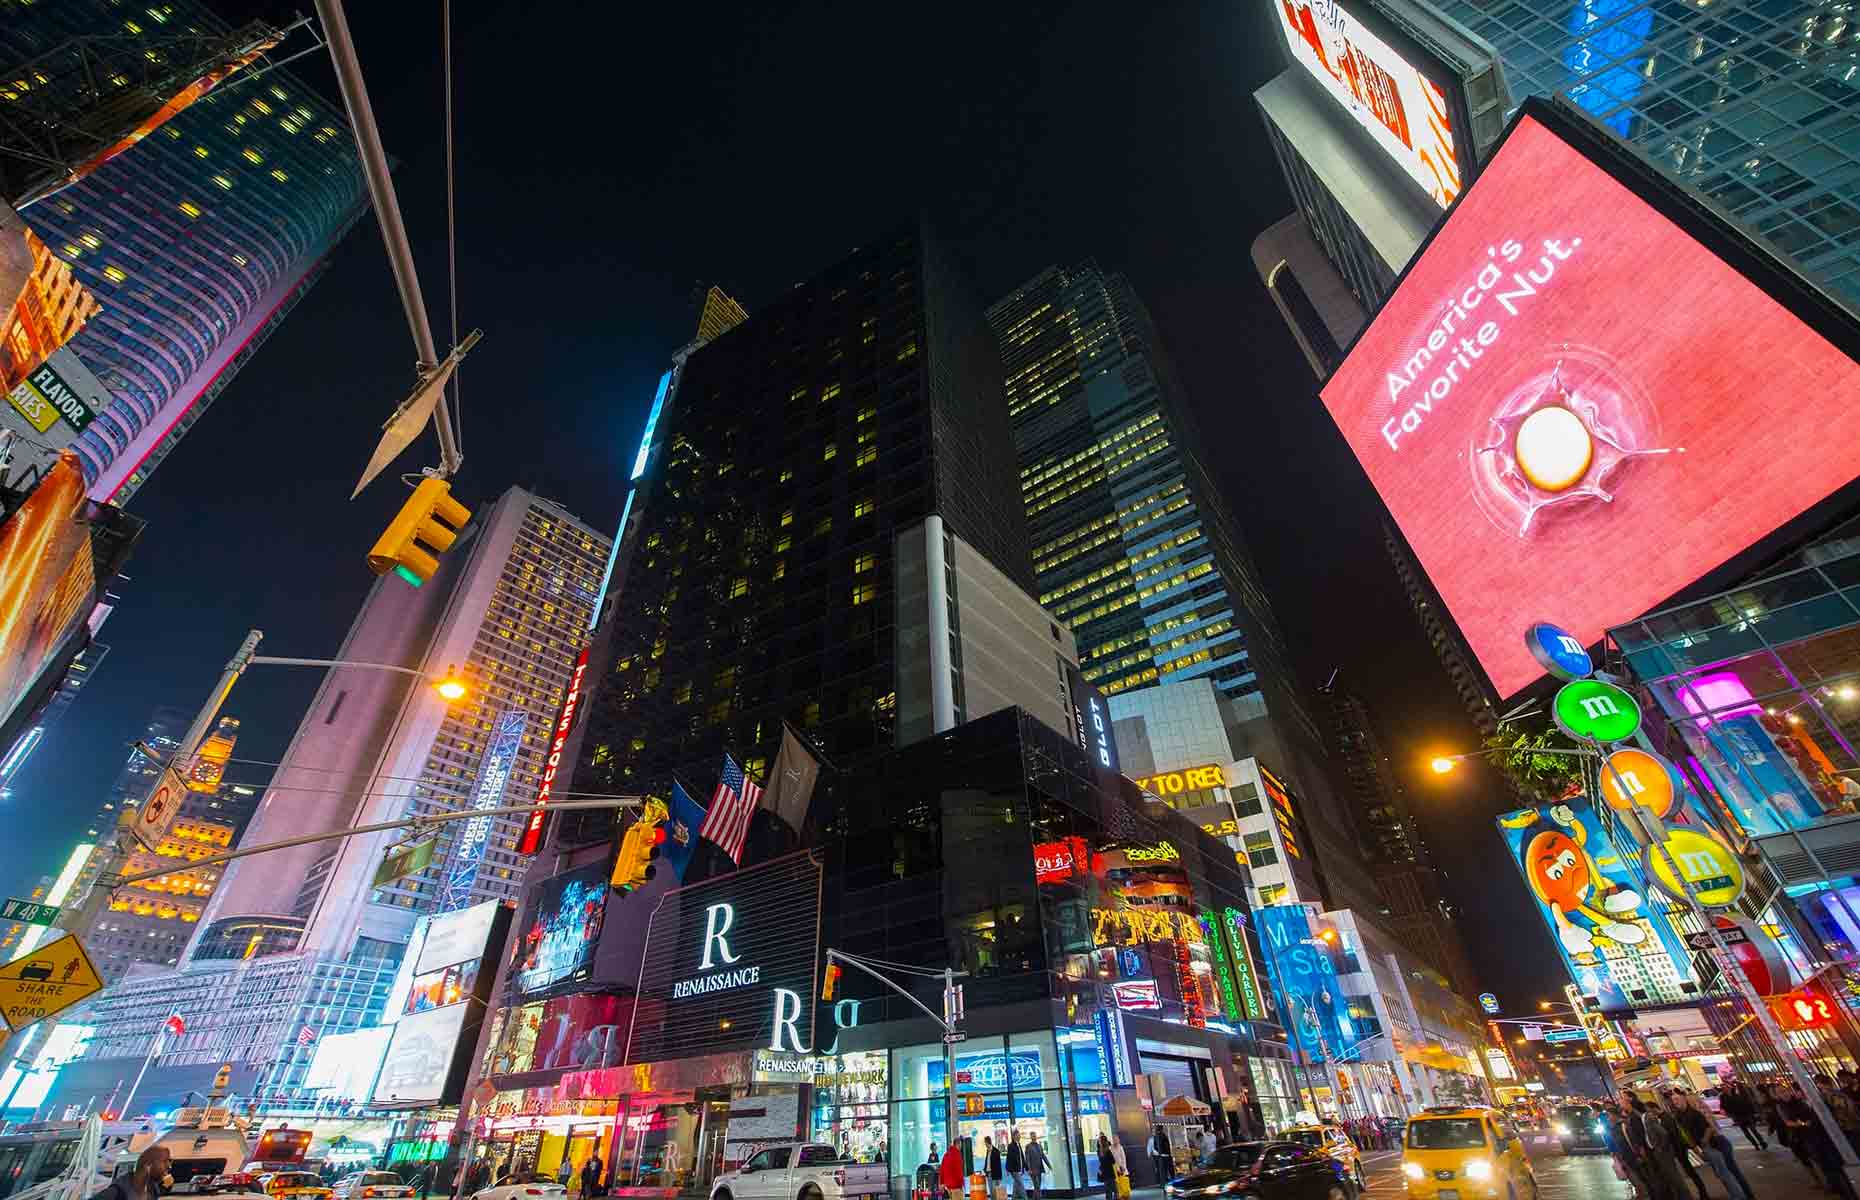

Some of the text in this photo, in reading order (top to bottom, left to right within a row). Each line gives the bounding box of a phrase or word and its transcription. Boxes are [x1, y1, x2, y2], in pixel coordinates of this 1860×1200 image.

[1381, 237, 1582, 451] Favorite Nut.
[1387, 240, 1522, 404] America's
[33, 368, 85, 427] FLAVOR.
[559, 663, 586, 732] TIMES
[475, 770, 507, 842] OUTITTERS
[1152, 773, 1184, 796] TO
[459, 793, 488, 859] AMERIAN
[20, 903, 39, 921] 48
[698, 903, 742, 970] R
[16, 982, 65, 996] SHARE
[673, 967, 760, 999] RENAISSANCE
[1226, 917, 1259, 1017] OLIVE GARDEN
[8, 1006, 47, 1018] ROAD
[769, 988, 813, 1054] R
